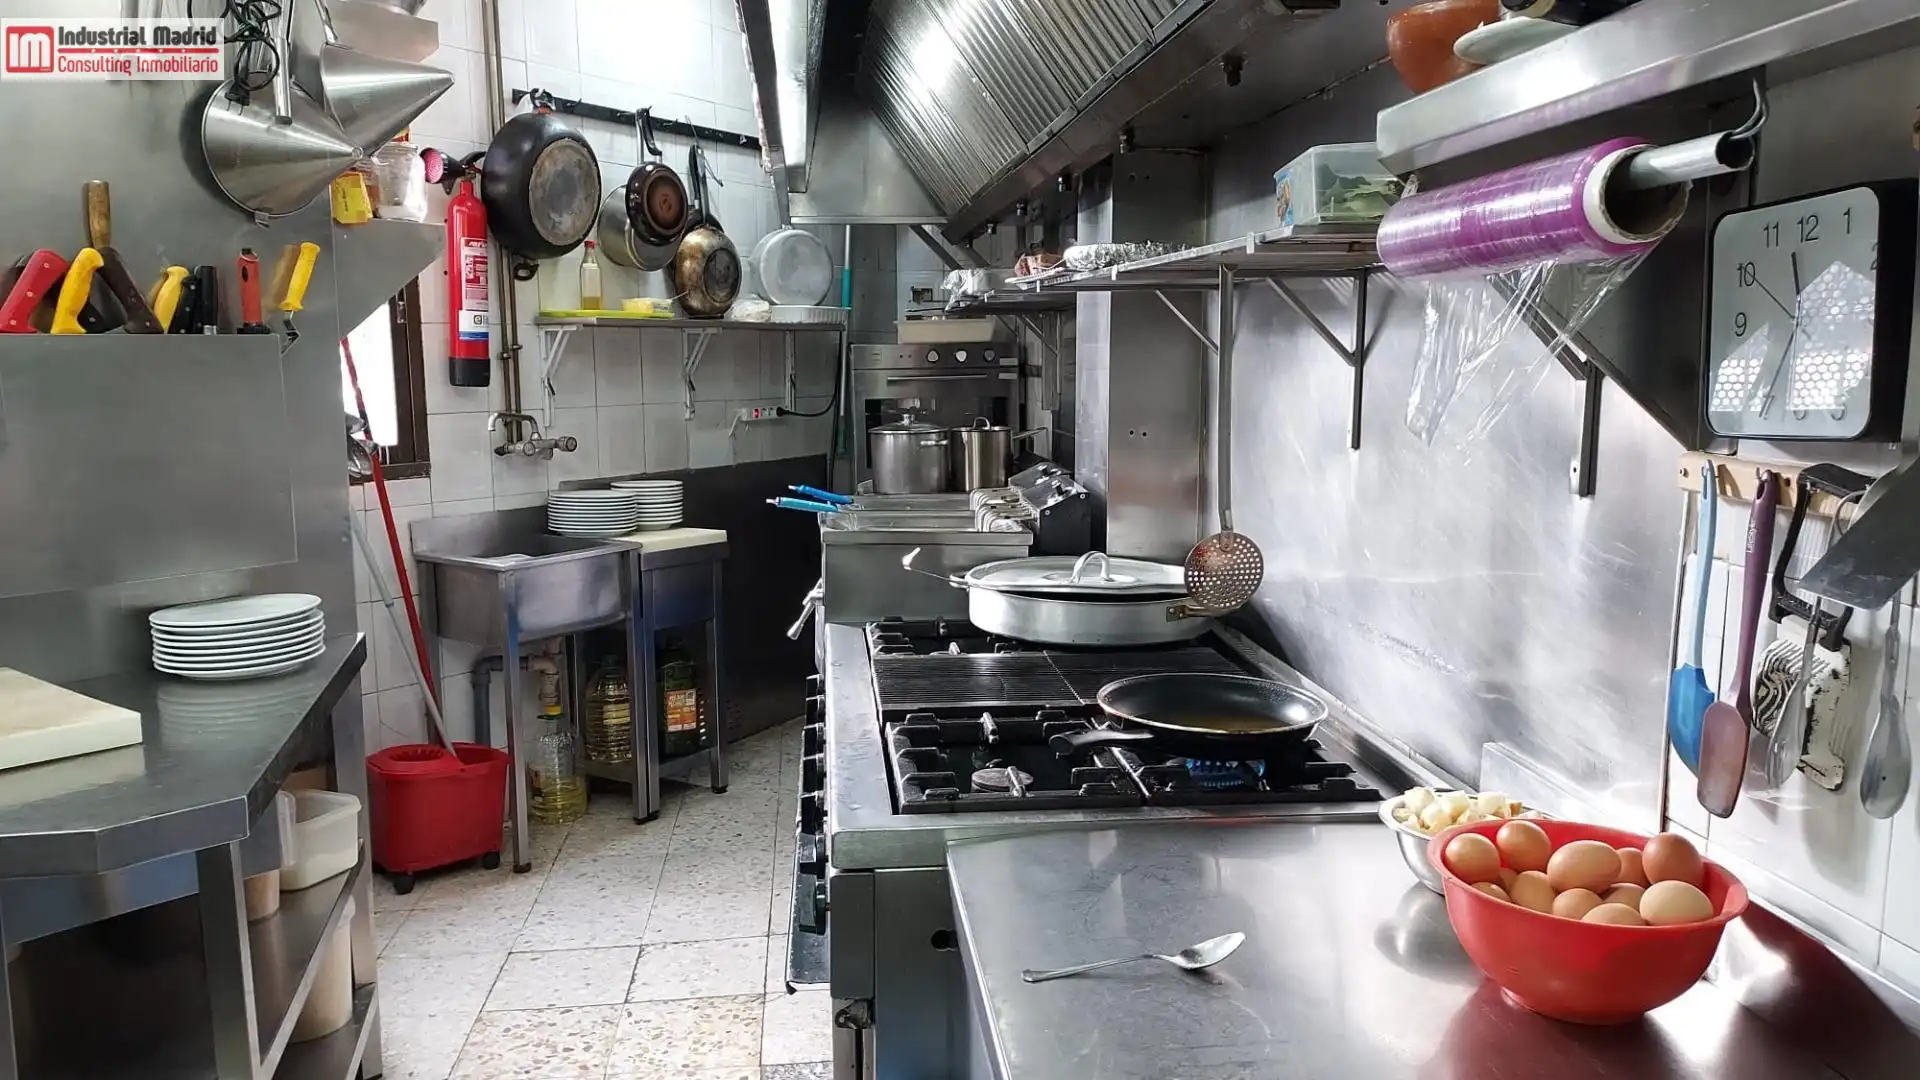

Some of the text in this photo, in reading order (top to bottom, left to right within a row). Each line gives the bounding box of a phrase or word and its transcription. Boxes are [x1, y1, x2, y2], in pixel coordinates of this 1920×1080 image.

[1763, 221, 1781, 249] 11
[1796, 214, 1820, 244] 12
[1843, 207, 1853, 235] 1
[1736, 261, 1757, 288] 10
[1734, 311, 1748, 338] 9
